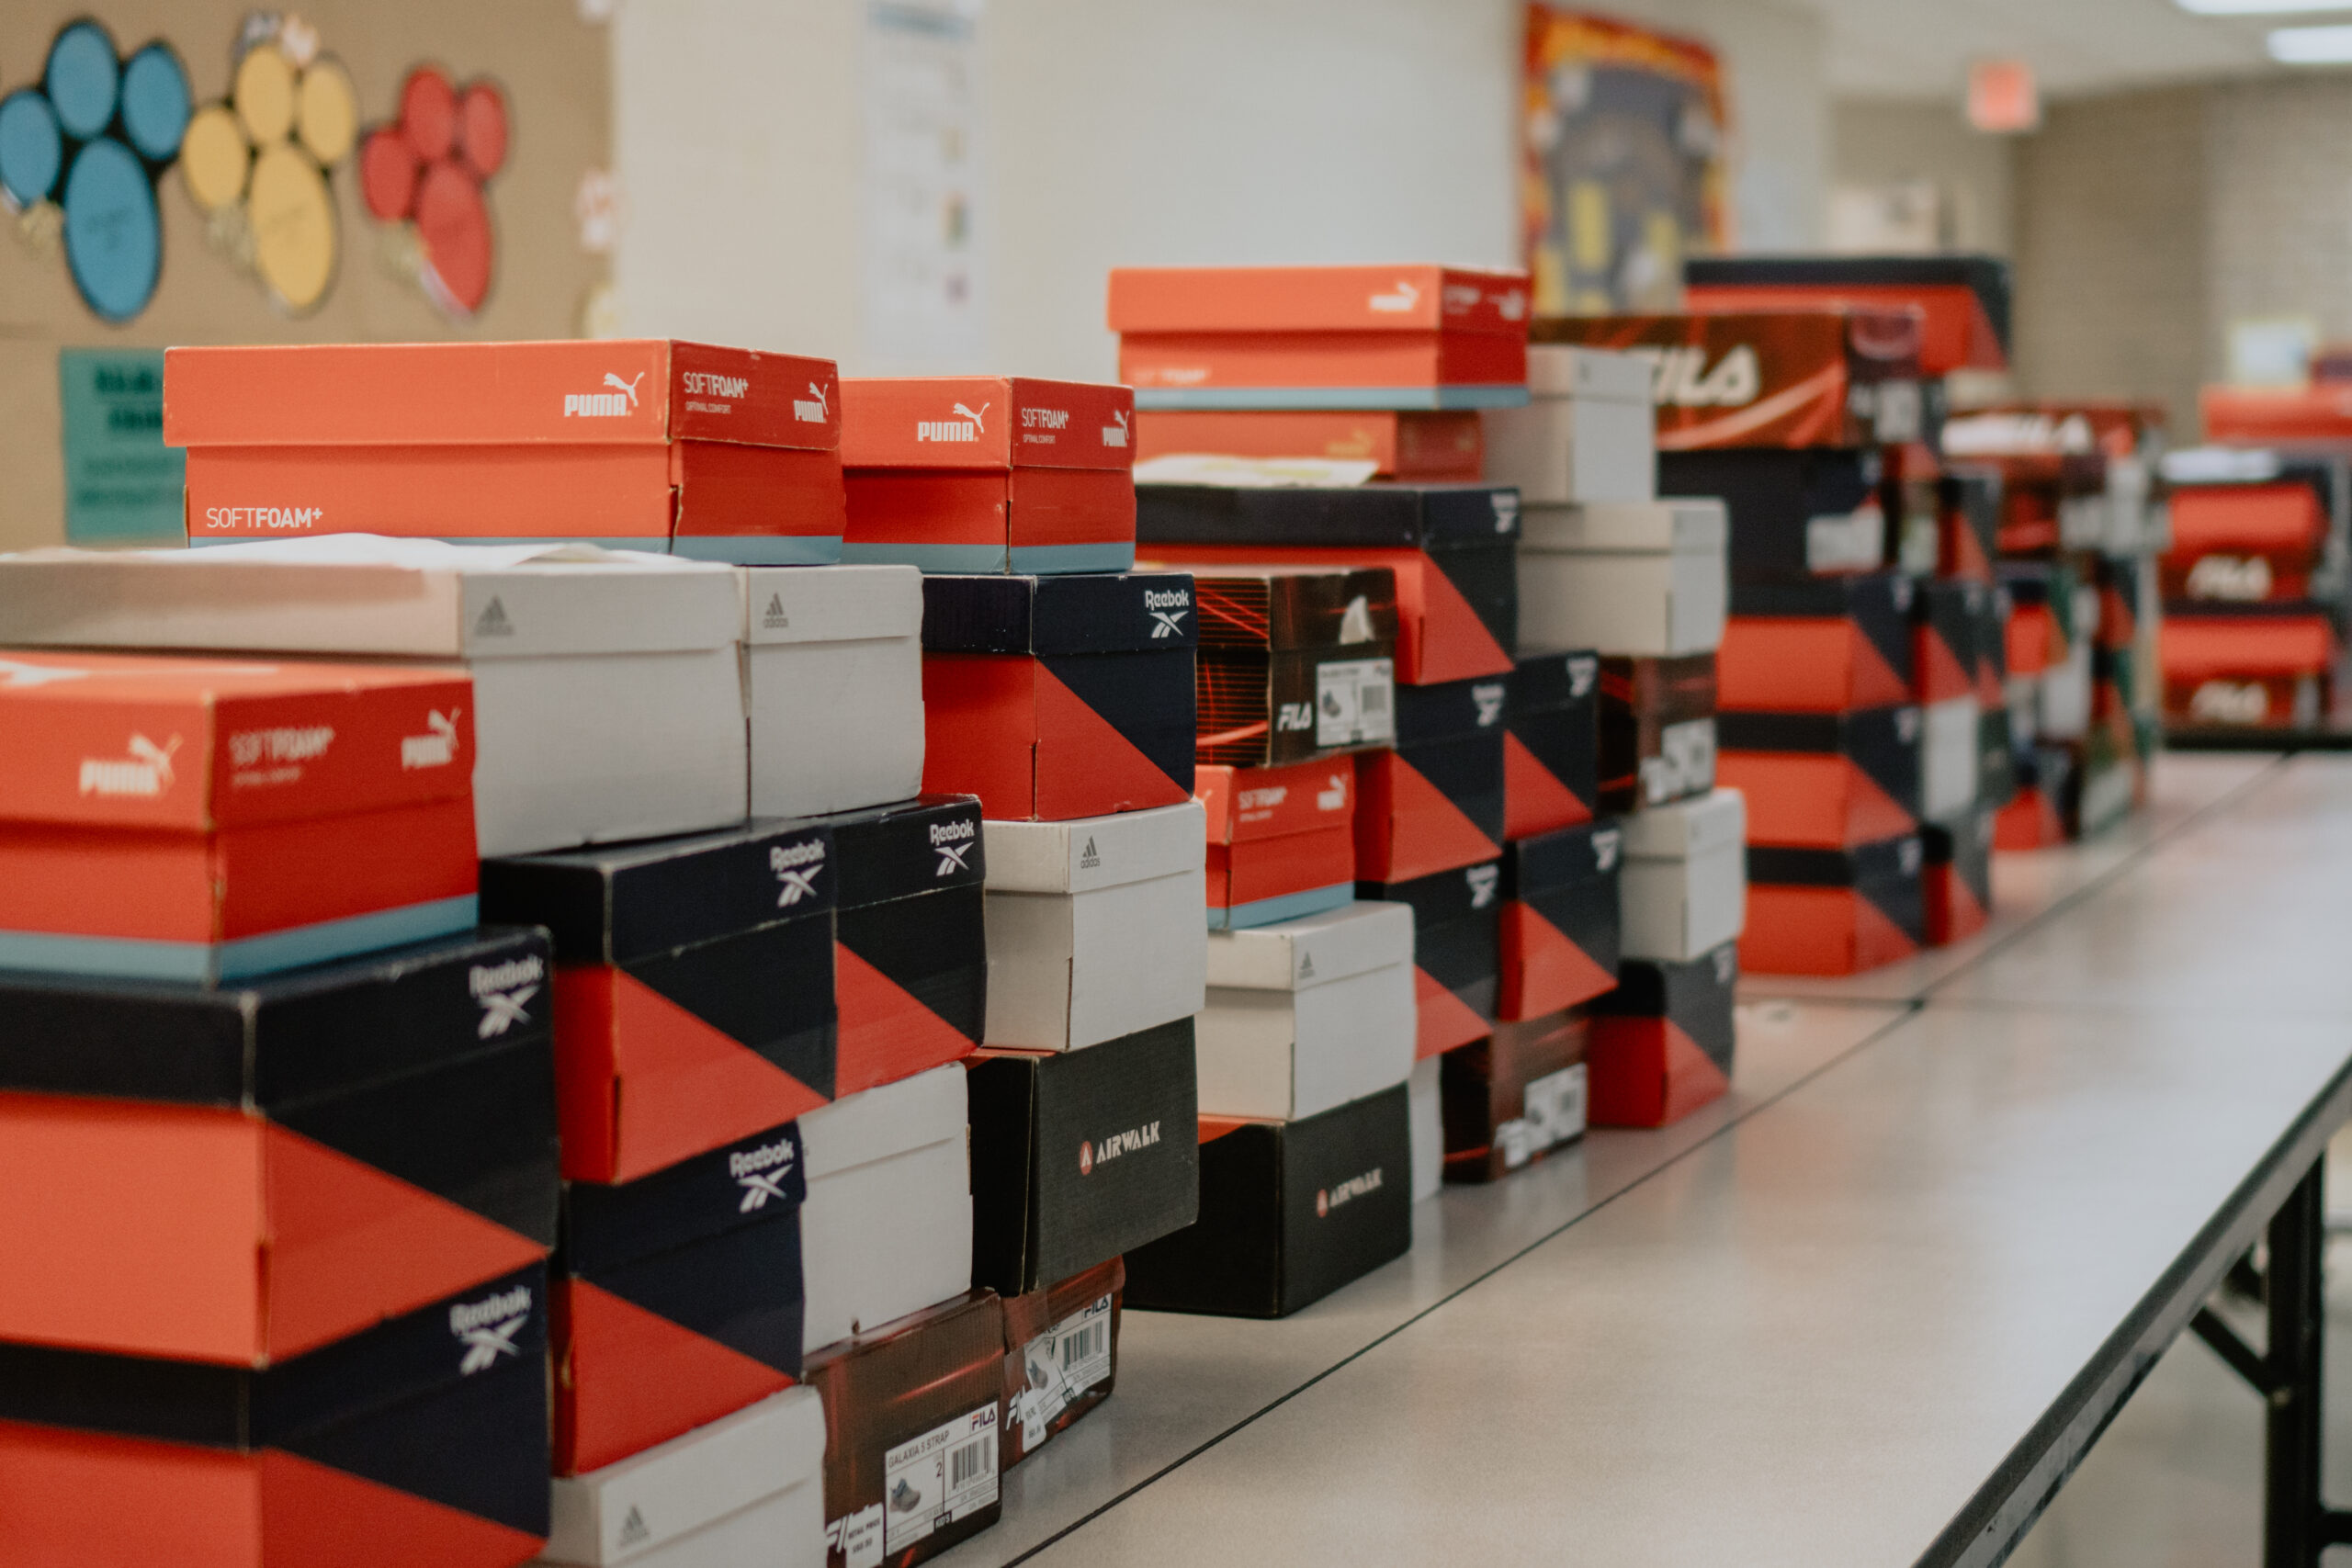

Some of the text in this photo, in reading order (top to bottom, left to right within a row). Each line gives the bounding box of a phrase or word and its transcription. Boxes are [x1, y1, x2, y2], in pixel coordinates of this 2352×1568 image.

[564, 393, 627, 417] PUMA
[793, 400, 825, 423] PUMA
[917, 421, 975, 442] PUMA
[206, 506, 324, 529] SOFTFOAM+
[1144, 588, 1190, 611] Reebok
[1277, 701, 1313, 732] FILA
[929, 818, 976, 846] Reebok
[769, 837, 826, 872] Reebok
[1095, 1120, 1161, 1165] AIRWALK
[729, 1137, 795, 1179] Reebok
[971, 1406, 996, 1431] FILA
[888, 1444, 920, 1469] GALAXIA
[926, 1428, 950, 1451] STRAP
[935, 1461, 943, 1478] 2
